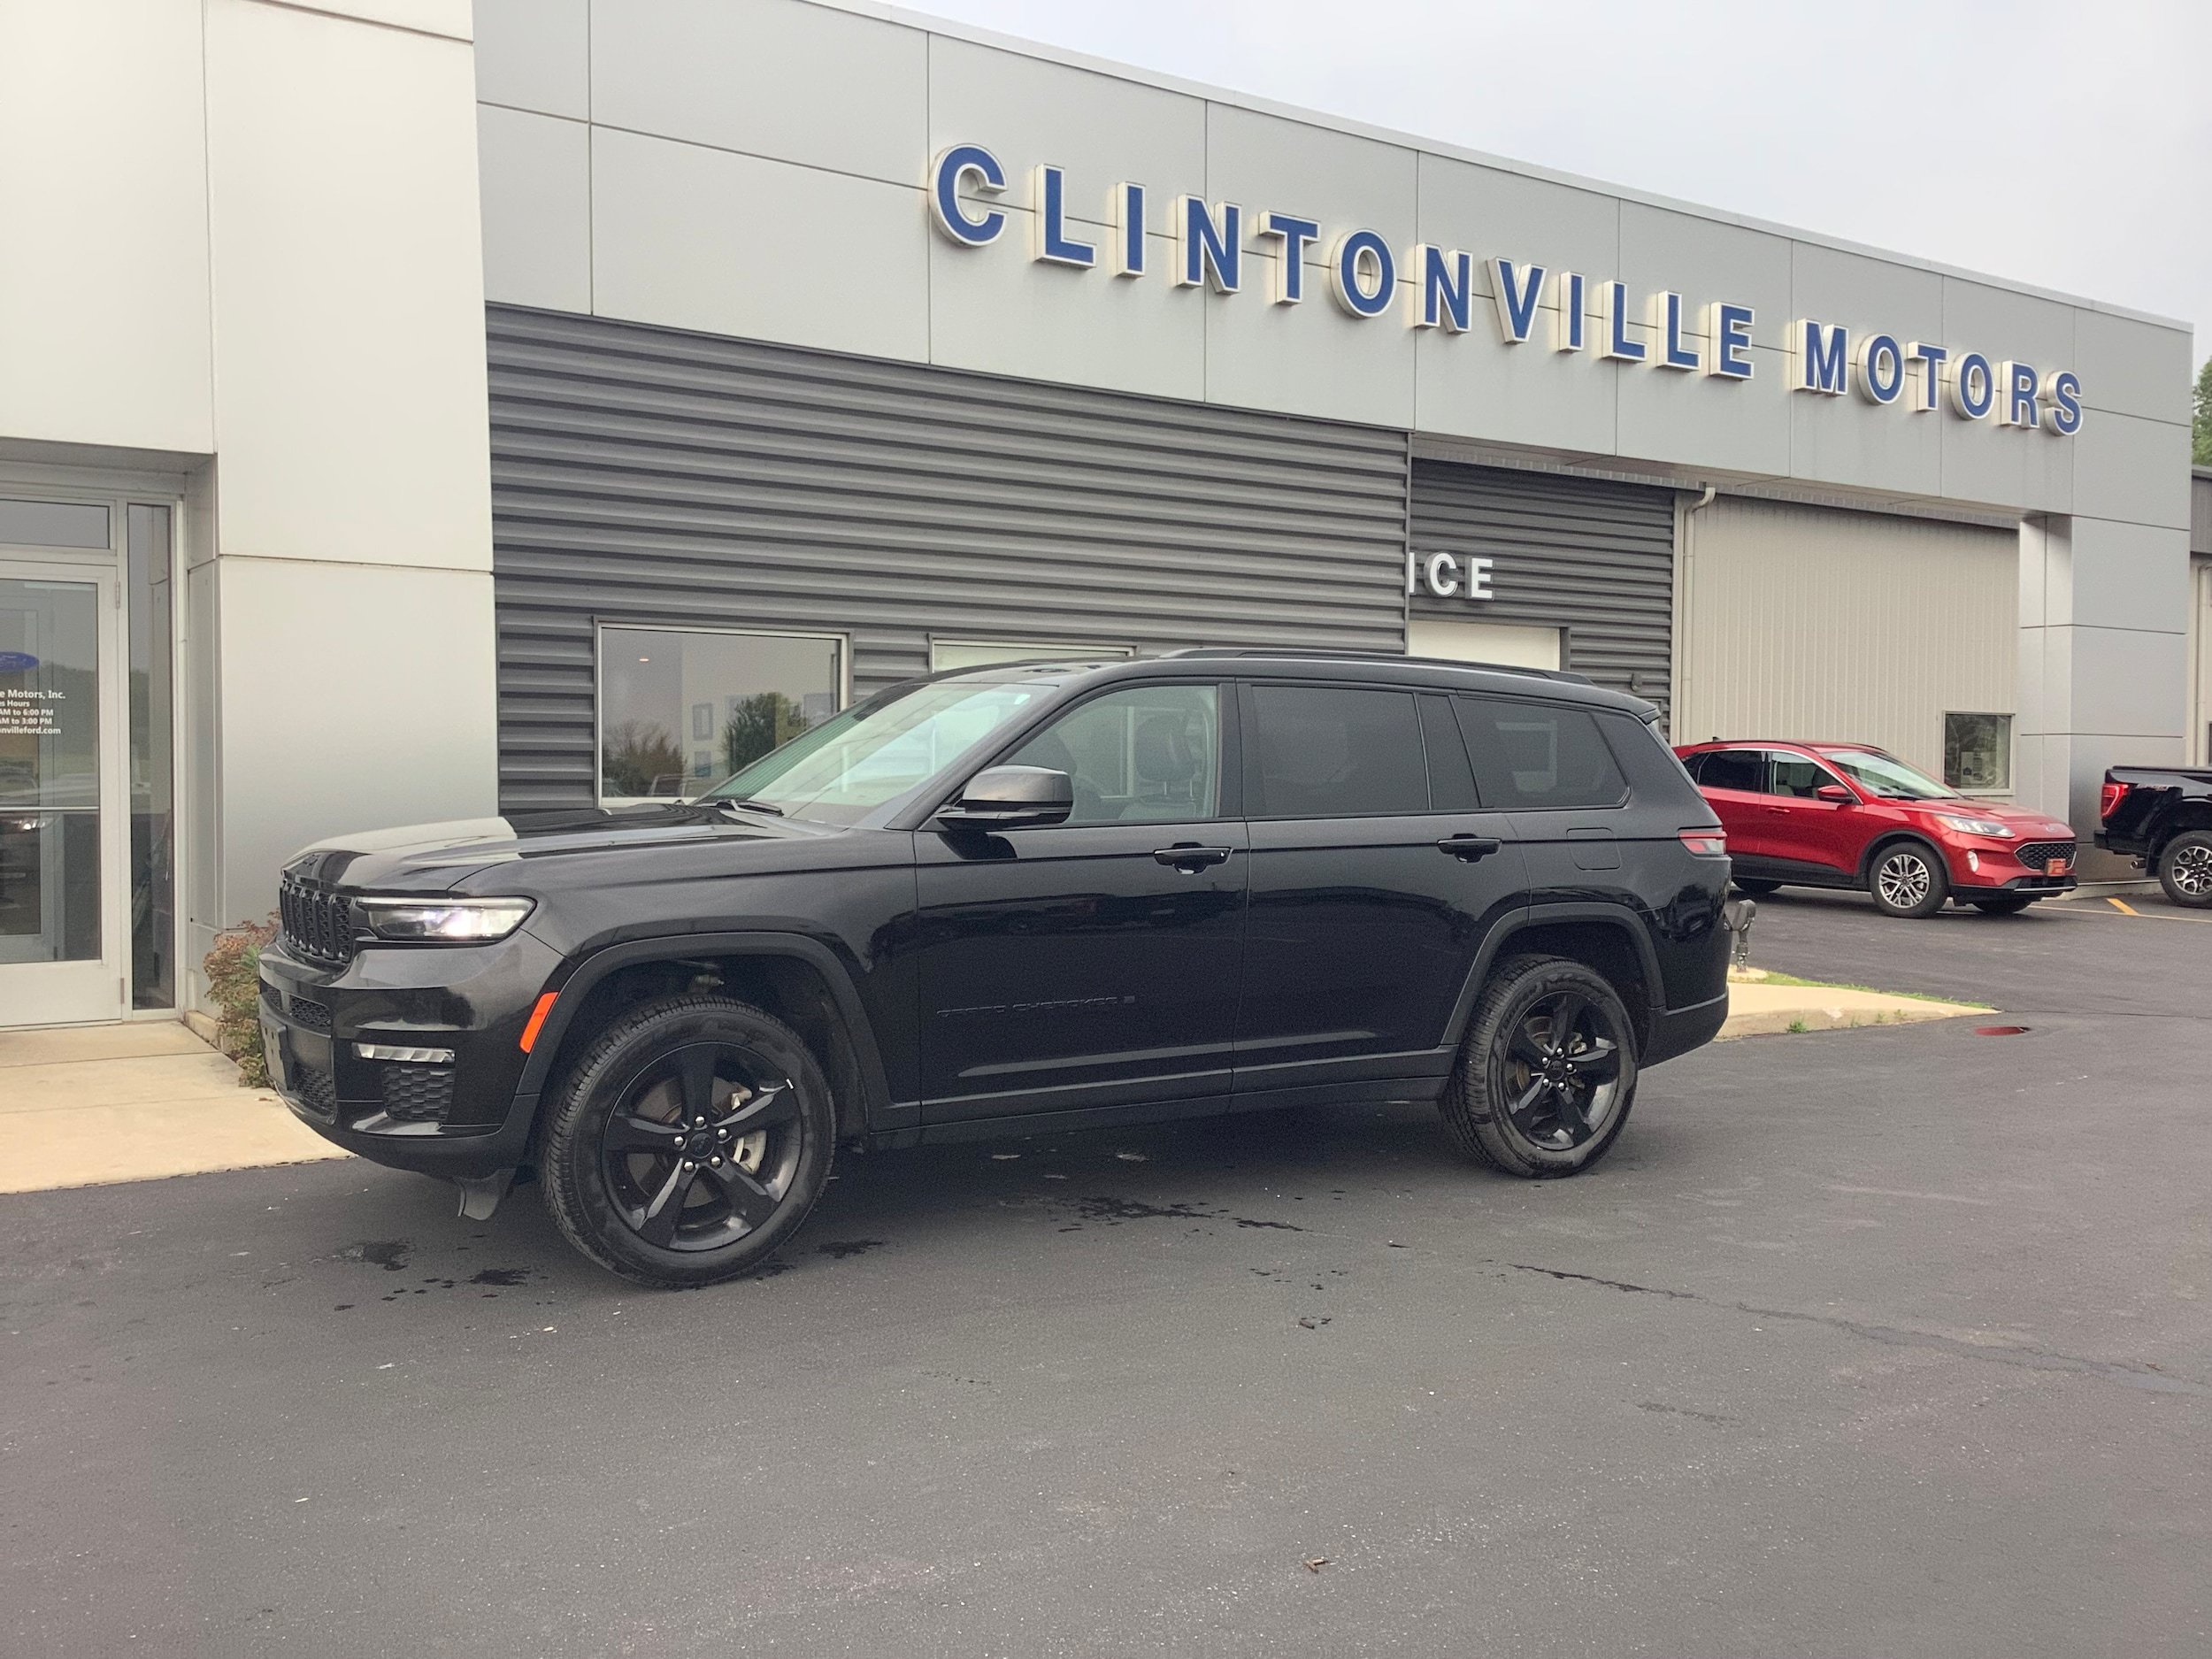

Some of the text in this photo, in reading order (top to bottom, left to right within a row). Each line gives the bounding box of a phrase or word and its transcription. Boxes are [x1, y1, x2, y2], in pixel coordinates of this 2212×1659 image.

[929, 142, 2084, 437] CLINTONVILLE MOTORS
[8, 689, 46, 700] Motors,
[48, 689, 66, 699] Inc.
[7, 699, 30, 708] Hours
